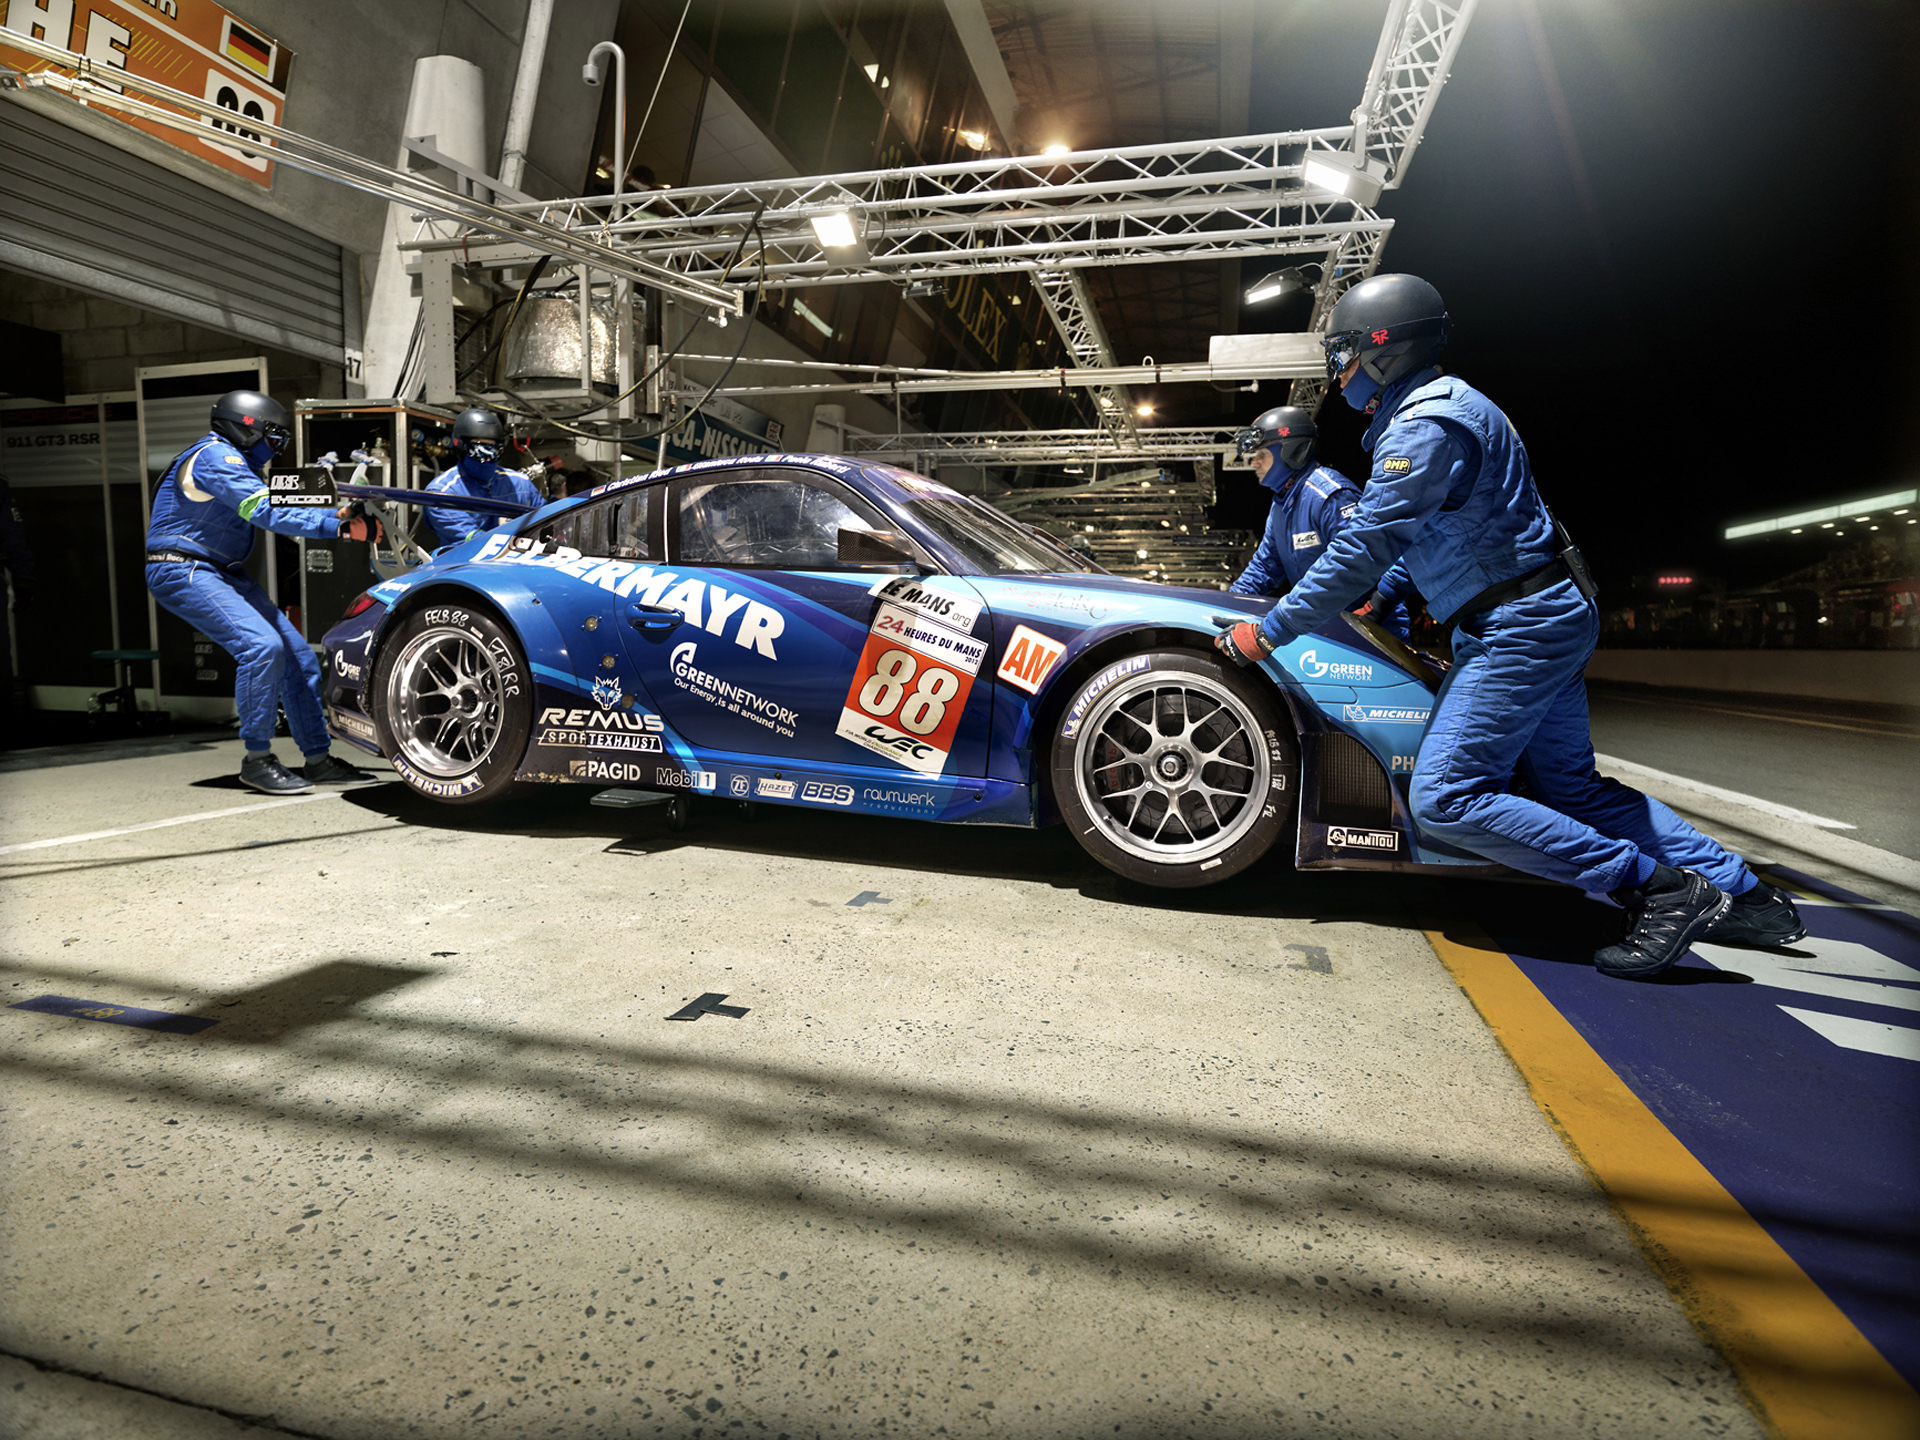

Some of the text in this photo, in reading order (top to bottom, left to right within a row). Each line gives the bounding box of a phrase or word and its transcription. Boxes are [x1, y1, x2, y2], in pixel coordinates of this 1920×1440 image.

[347, 356, 361, 379] 17
[7, 432, 100, 449] 911 GT3 RSR
[469, 534, 786, 661] FELBERMAYR
[878, 580, 905, 597] LE
[876, 615, 982, 658] 24 HEURES DU MANS
[1002, 636, 1058, 687] AM
[1329, 663, 1373, 676] GREEN
[1072, 656, 1148, 718] MICHELIN
[1329, 672, 1373, 681] NETWORK
[858, 648, 960, 736] 88
[674, 677, 690, 689] Our
[727, 702, 740, 713] all
[740, 708, 775, 729] around
[776, 724, 795, 738] you
[1368, 709, 1430, 720] MICHELI
[338, 714, 374, 736] MICHELIN
[538, 707, 665, 732] REMUS
[548, 731, 656, 750] SPORTEXHAUST
[863, 725, 934, 760] WEC
[393, 759, 462, 796] MICHELIN
[588, 760, 641, 781] PAGID
[656, 767, 699, 788] Mobil
[733, 779, 746, 791] ZF
[760, 782, 793, 793] HAZET
[801, 781, 854, 805] BBS
[863, 788, 935, 807] raumwerk
[1346, 832, 1394, 848] MANITOU
